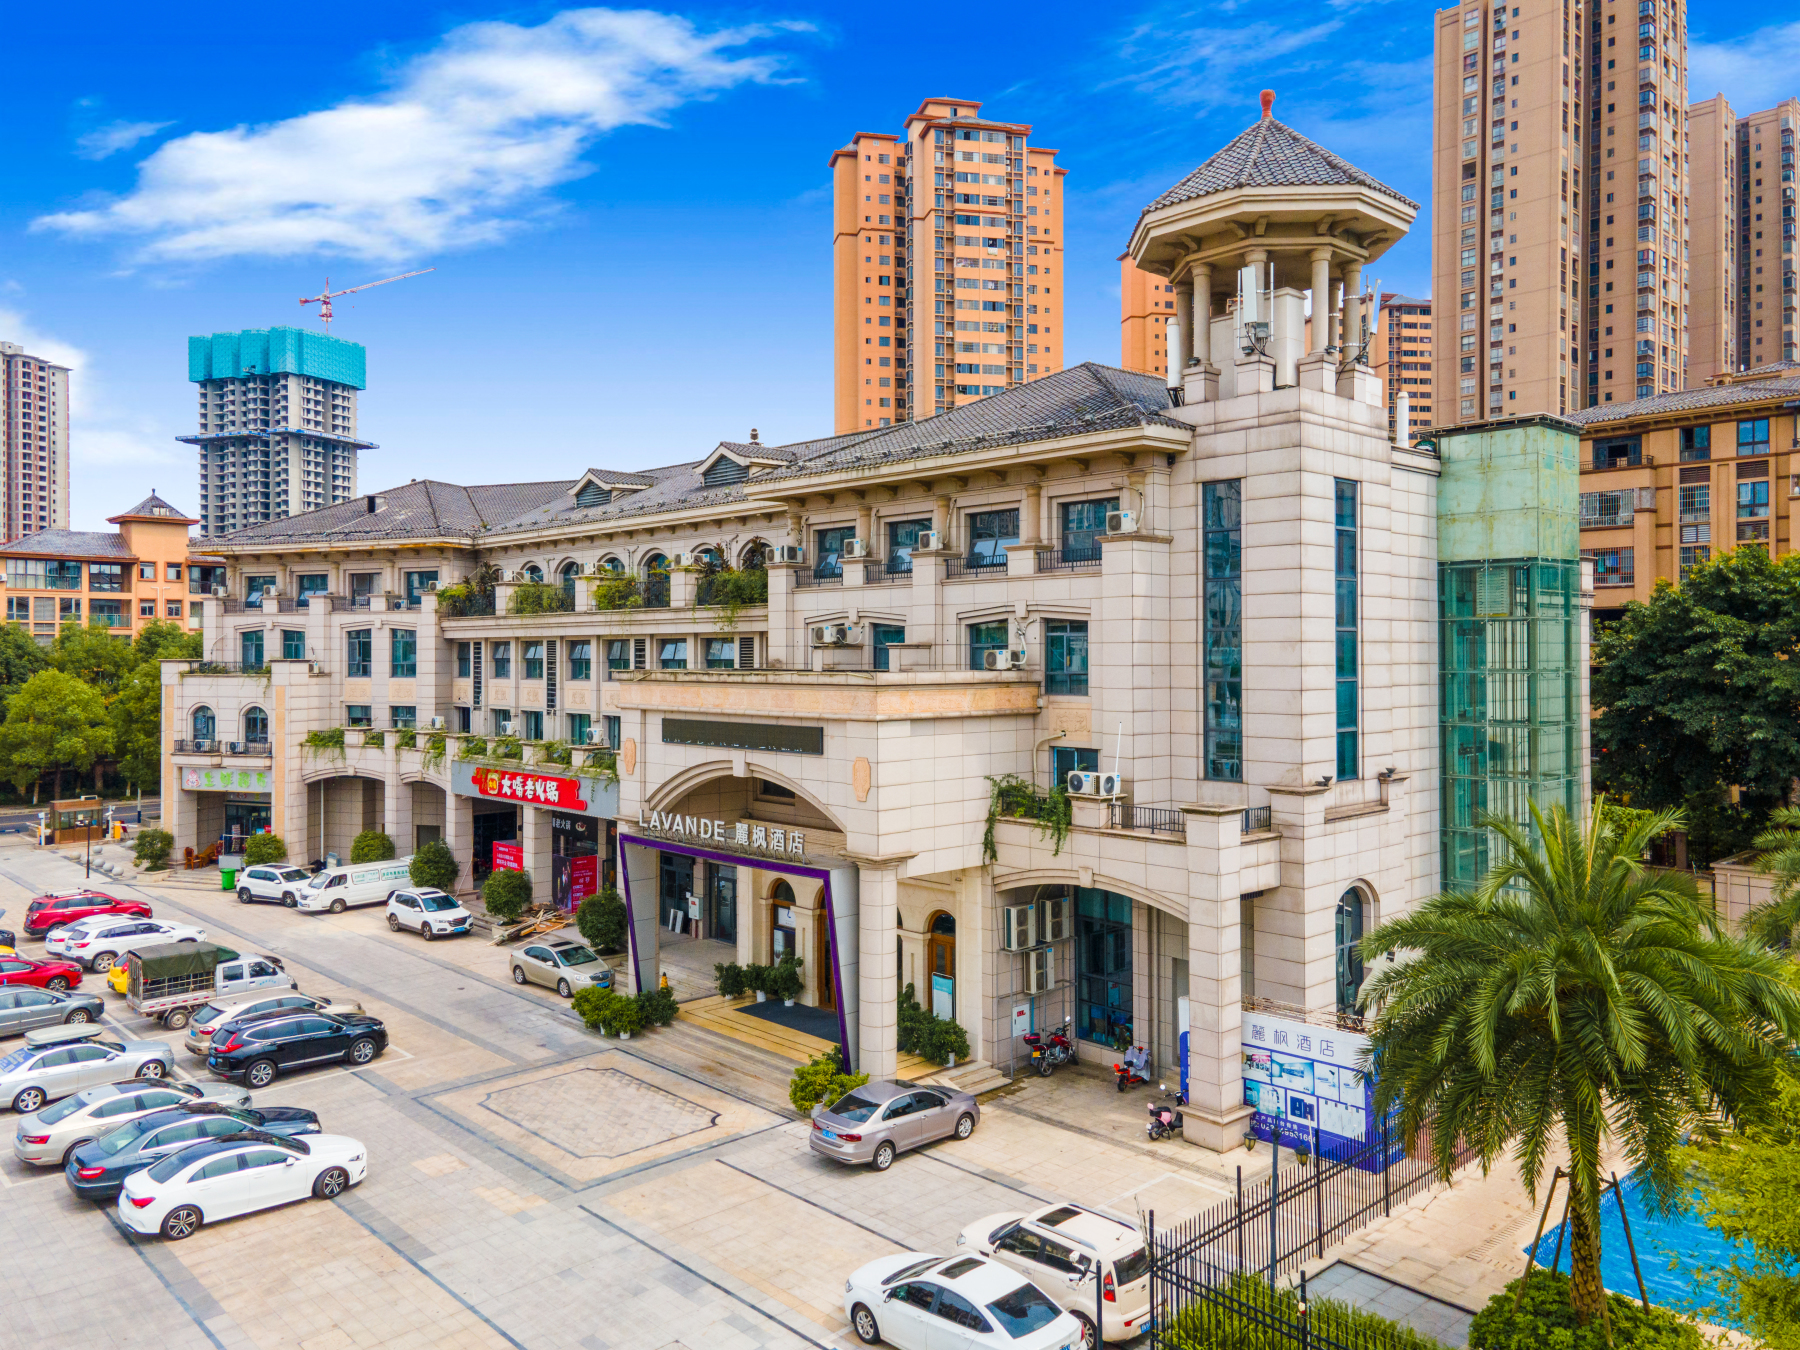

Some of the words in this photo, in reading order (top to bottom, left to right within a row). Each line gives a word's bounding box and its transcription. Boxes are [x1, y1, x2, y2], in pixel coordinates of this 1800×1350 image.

[501, 774, 559, 803] 大嘴老火锅
[639, 809, 725, 841] LAVANDE
